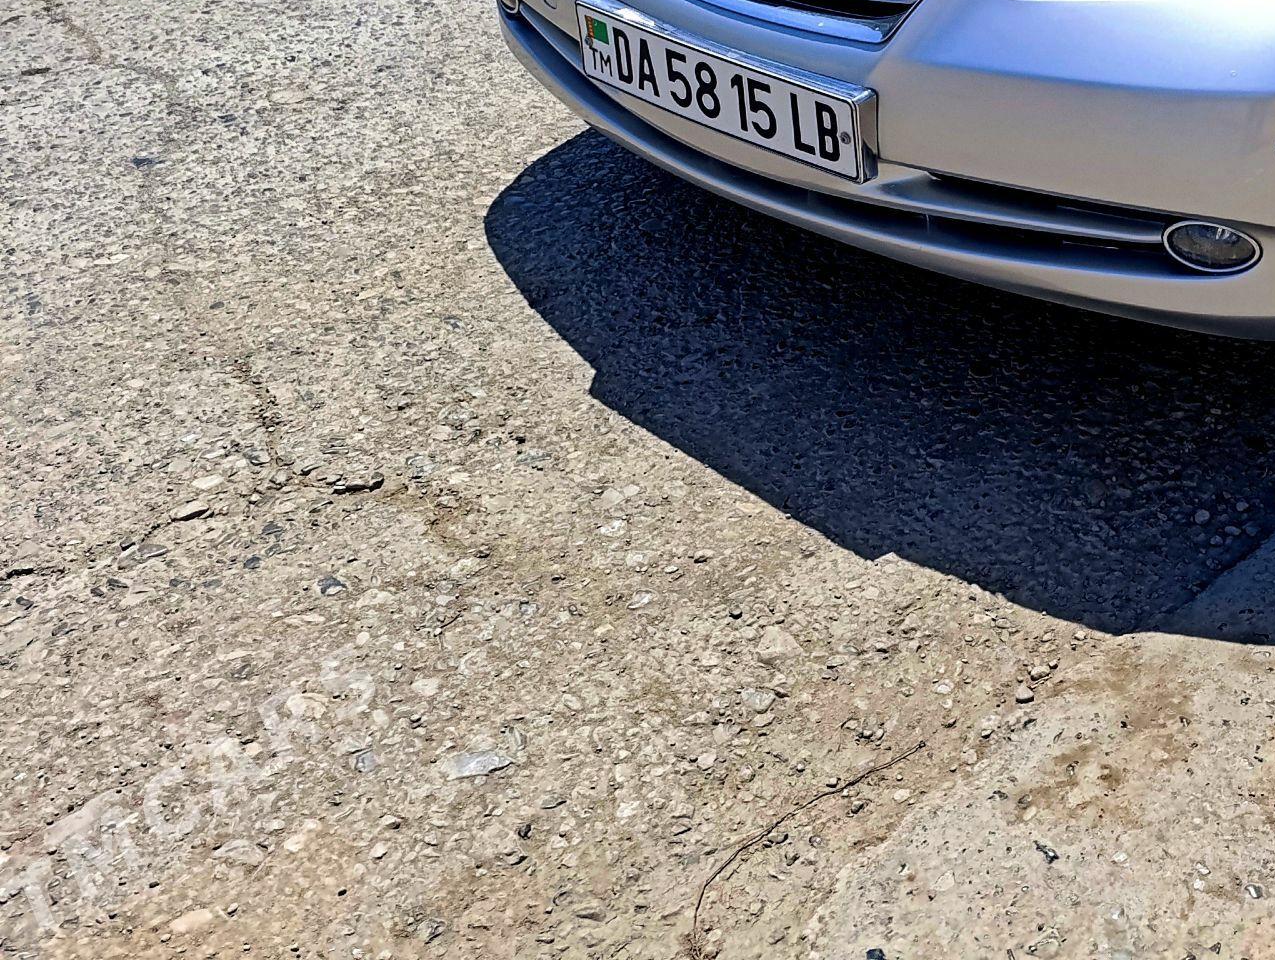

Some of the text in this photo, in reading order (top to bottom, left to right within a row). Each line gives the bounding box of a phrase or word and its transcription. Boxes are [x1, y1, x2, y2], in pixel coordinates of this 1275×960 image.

[589, 46, 613, 77] TM
[613, 27, 841, 162] DA 58 15 LB
